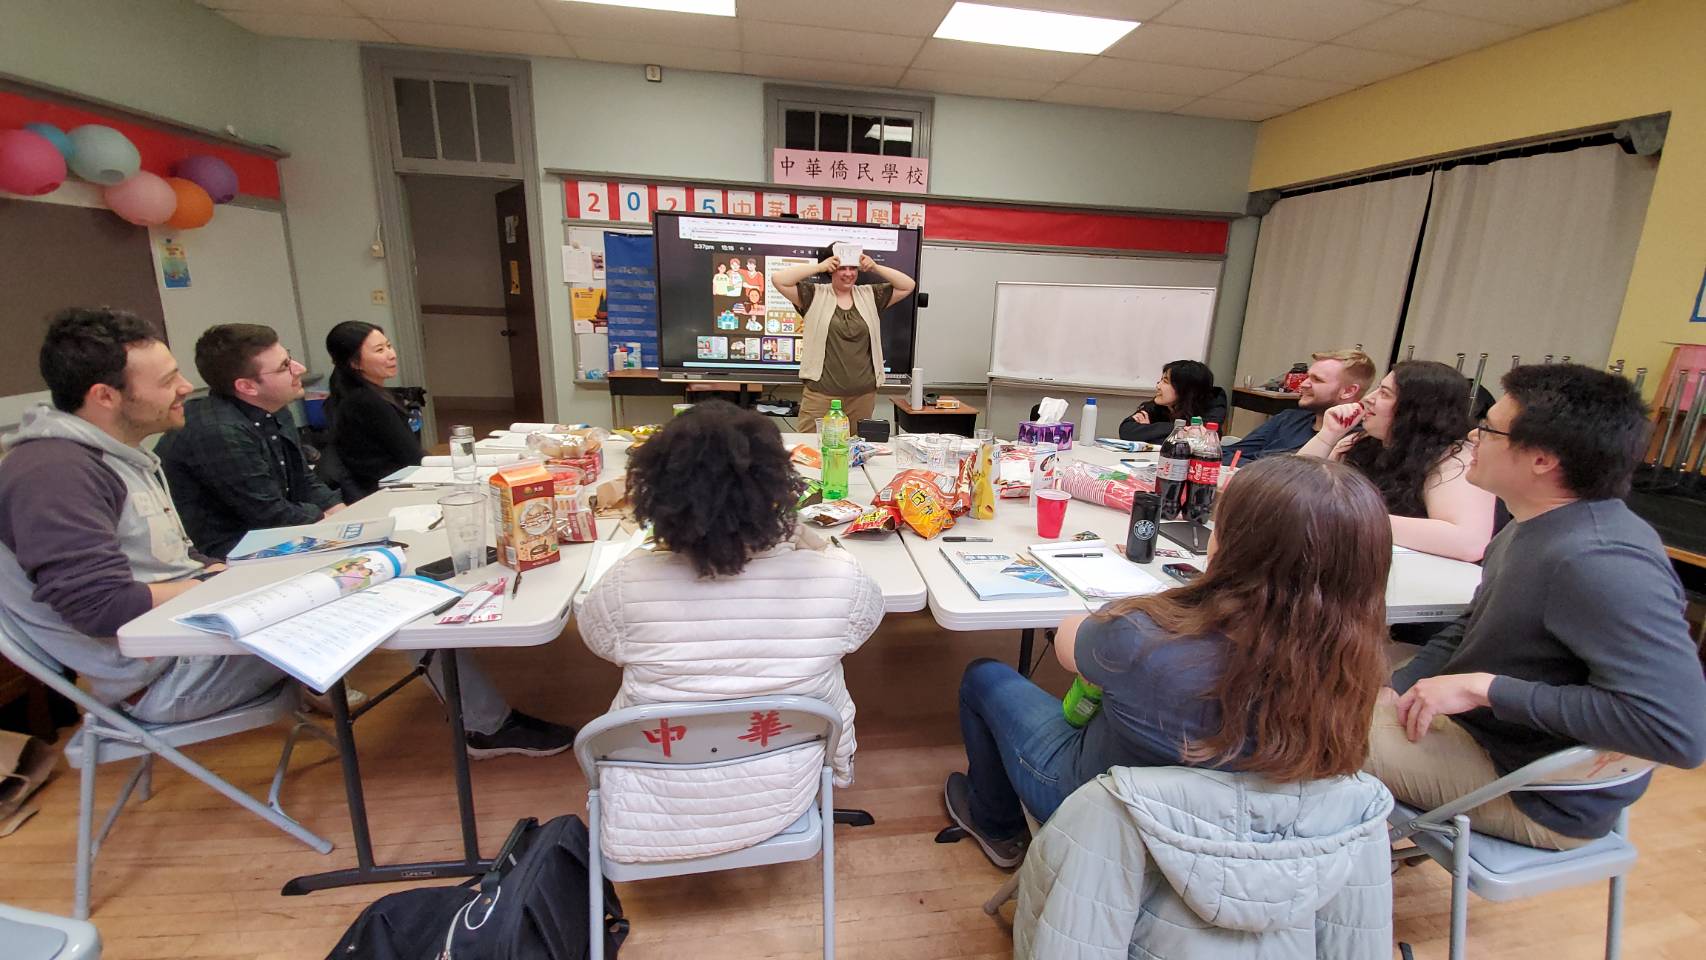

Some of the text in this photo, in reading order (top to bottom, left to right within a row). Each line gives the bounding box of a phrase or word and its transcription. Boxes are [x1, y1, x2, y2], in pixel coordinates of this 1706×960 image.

[780, 156, 924, 185] 中華僑民學校
